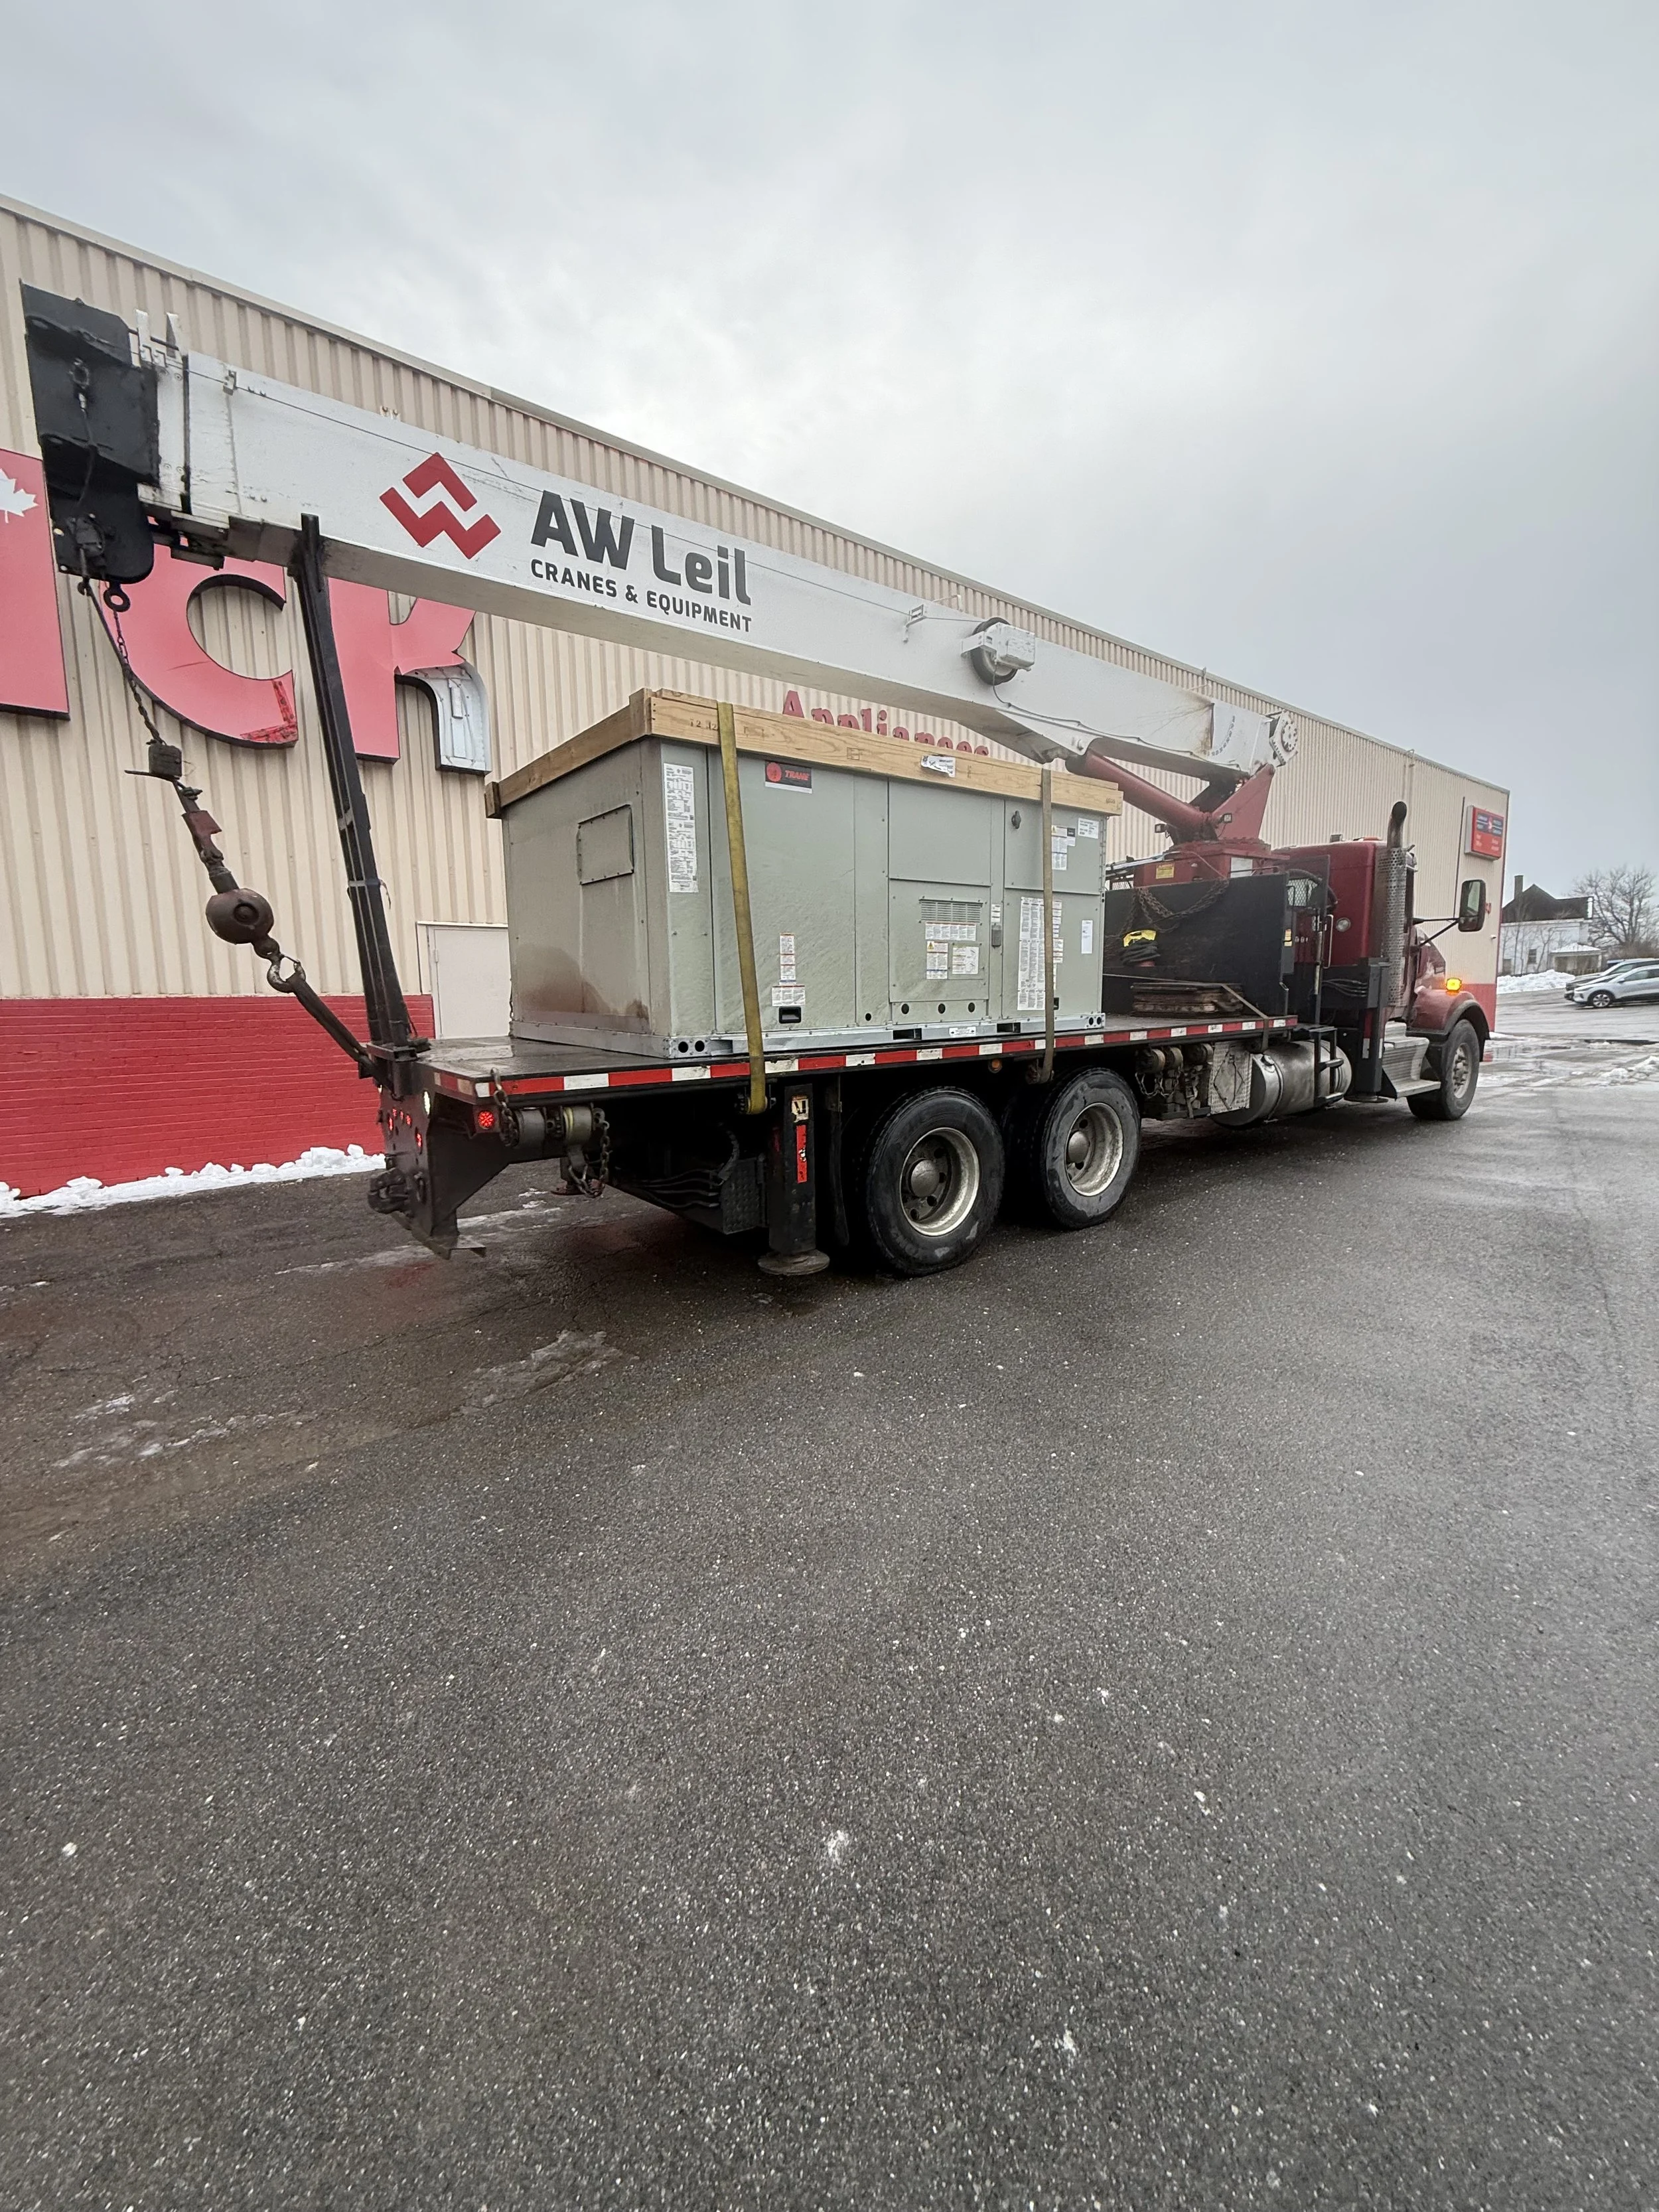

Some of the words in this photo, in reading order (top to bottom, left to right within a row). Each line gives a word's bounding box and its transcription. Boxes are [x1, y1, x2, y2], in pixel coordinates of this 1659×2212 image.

[531, 490, 635, 570] AW
[651, 524, 751, 605] Leil
[531, 559, 617, 597] CRANES
[625, 585, 638, 604] &
[646, 590, 752, 632] EQUIPMENT
[784, 769, 810, 781] TRANE
